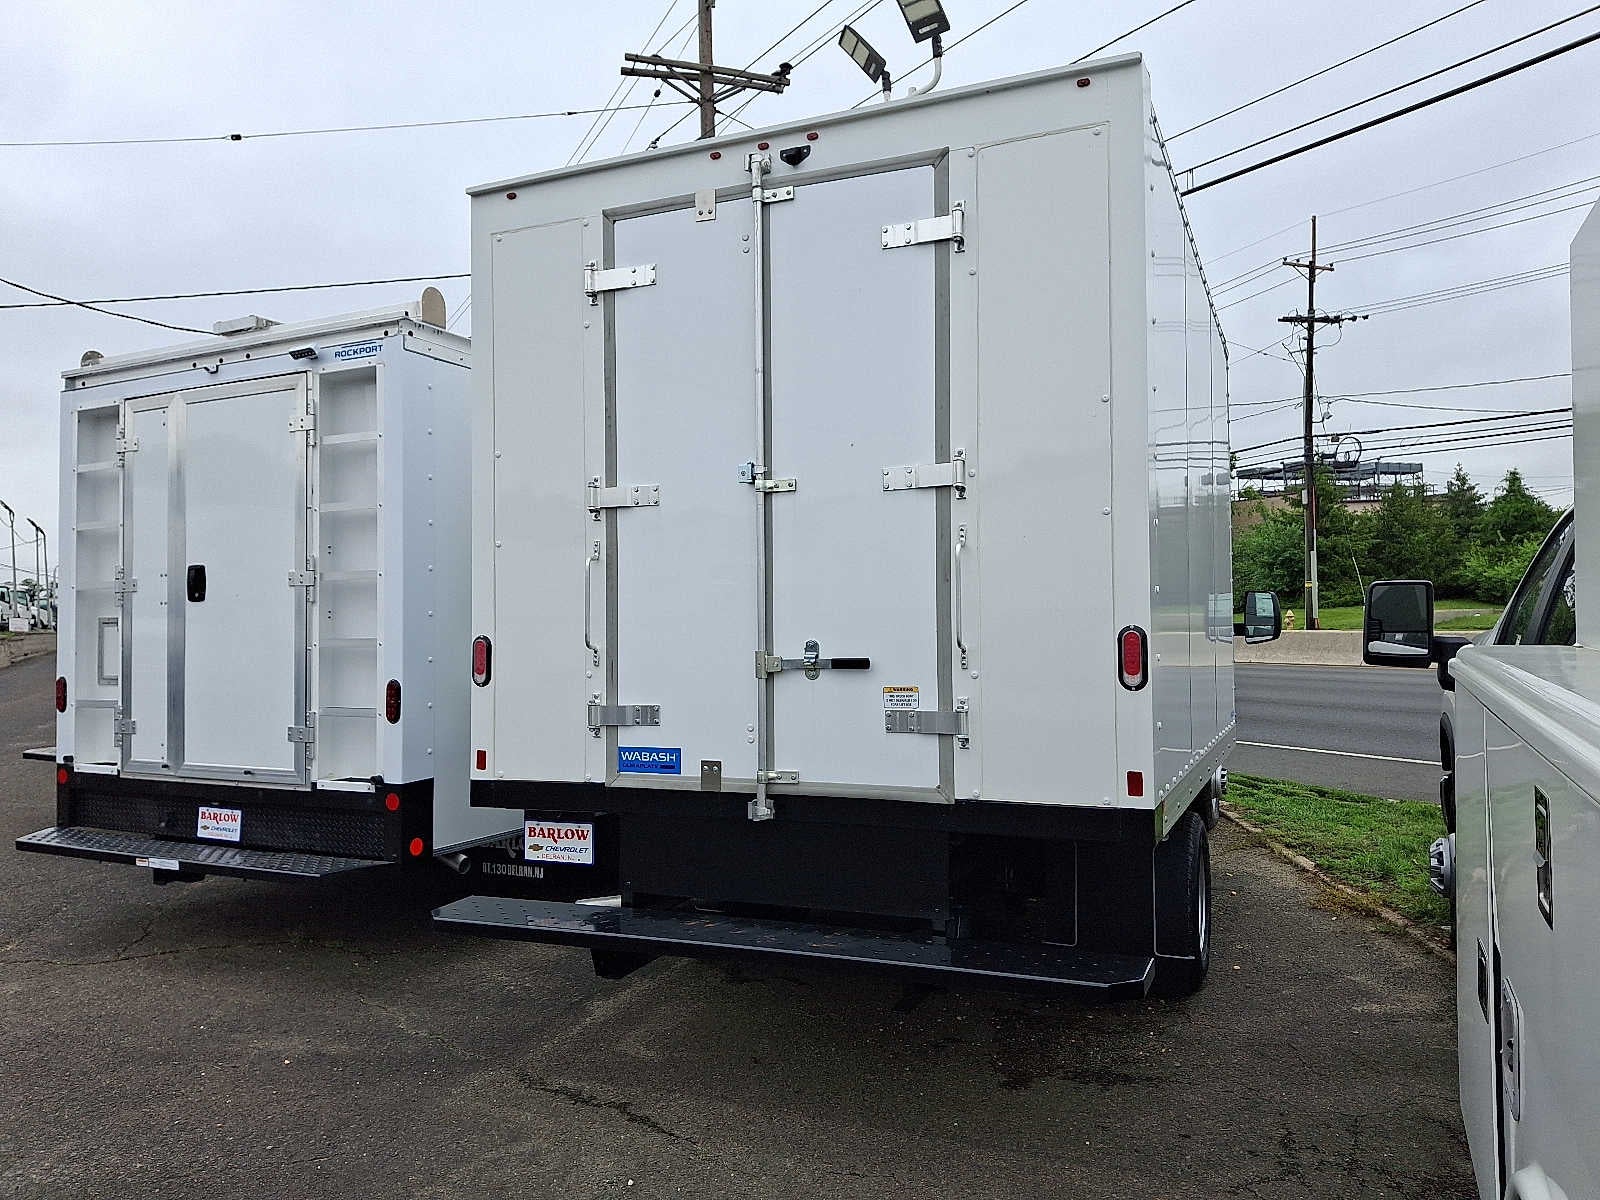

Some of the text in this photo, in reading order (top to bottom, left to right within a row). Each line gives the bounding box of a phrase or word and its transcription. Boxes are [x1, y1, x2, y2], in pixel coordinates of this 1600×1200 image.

[334, 344, 384, 359] ROCKPORT
[620, 751, 676, 762] WABASH
[200, 811, 239, 824] BARLOW
[527, 826, 590, 845] BARLOW
[545, 845, 589, 854] CHEVROLET
